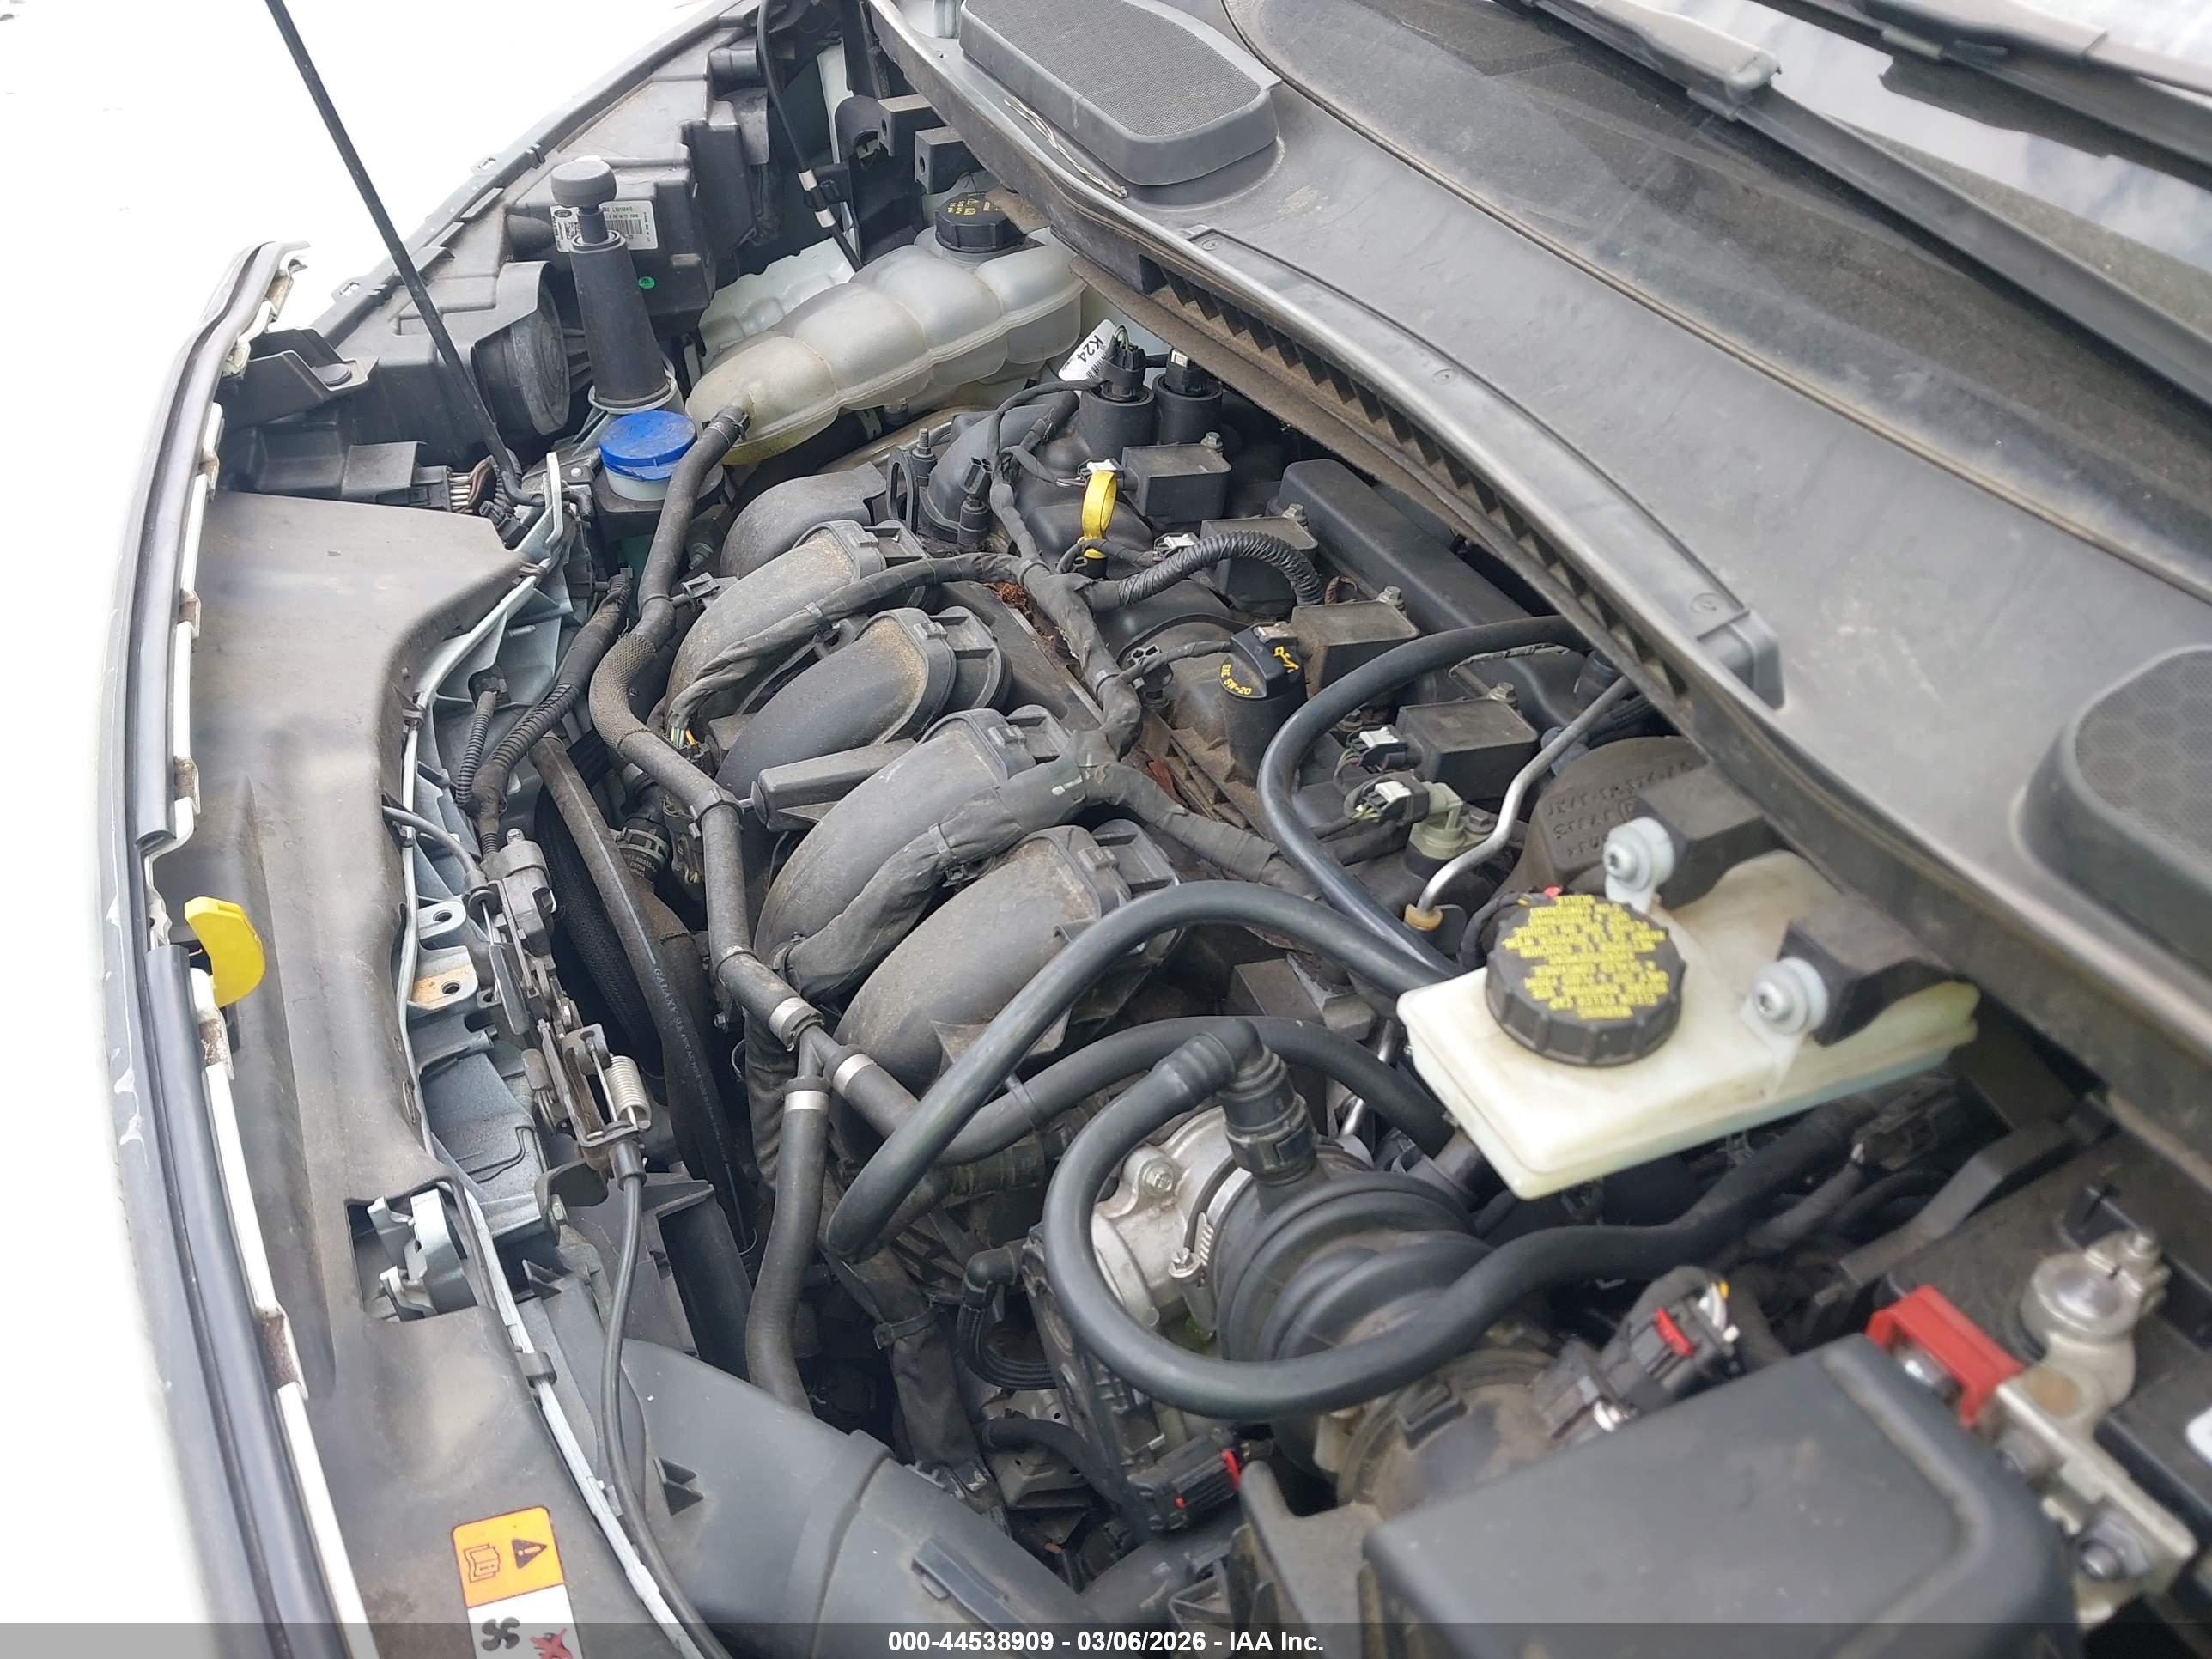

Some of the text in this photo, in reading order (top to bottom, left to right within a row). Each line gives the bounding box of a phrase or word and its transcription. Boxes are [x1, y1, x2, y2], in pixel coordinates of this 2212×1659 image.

[1077, 335, 1103, 362] K24
[1221, 664, 1252, 695] SAE 5W-20
[653, 968, 678, 1013] GALAXY
